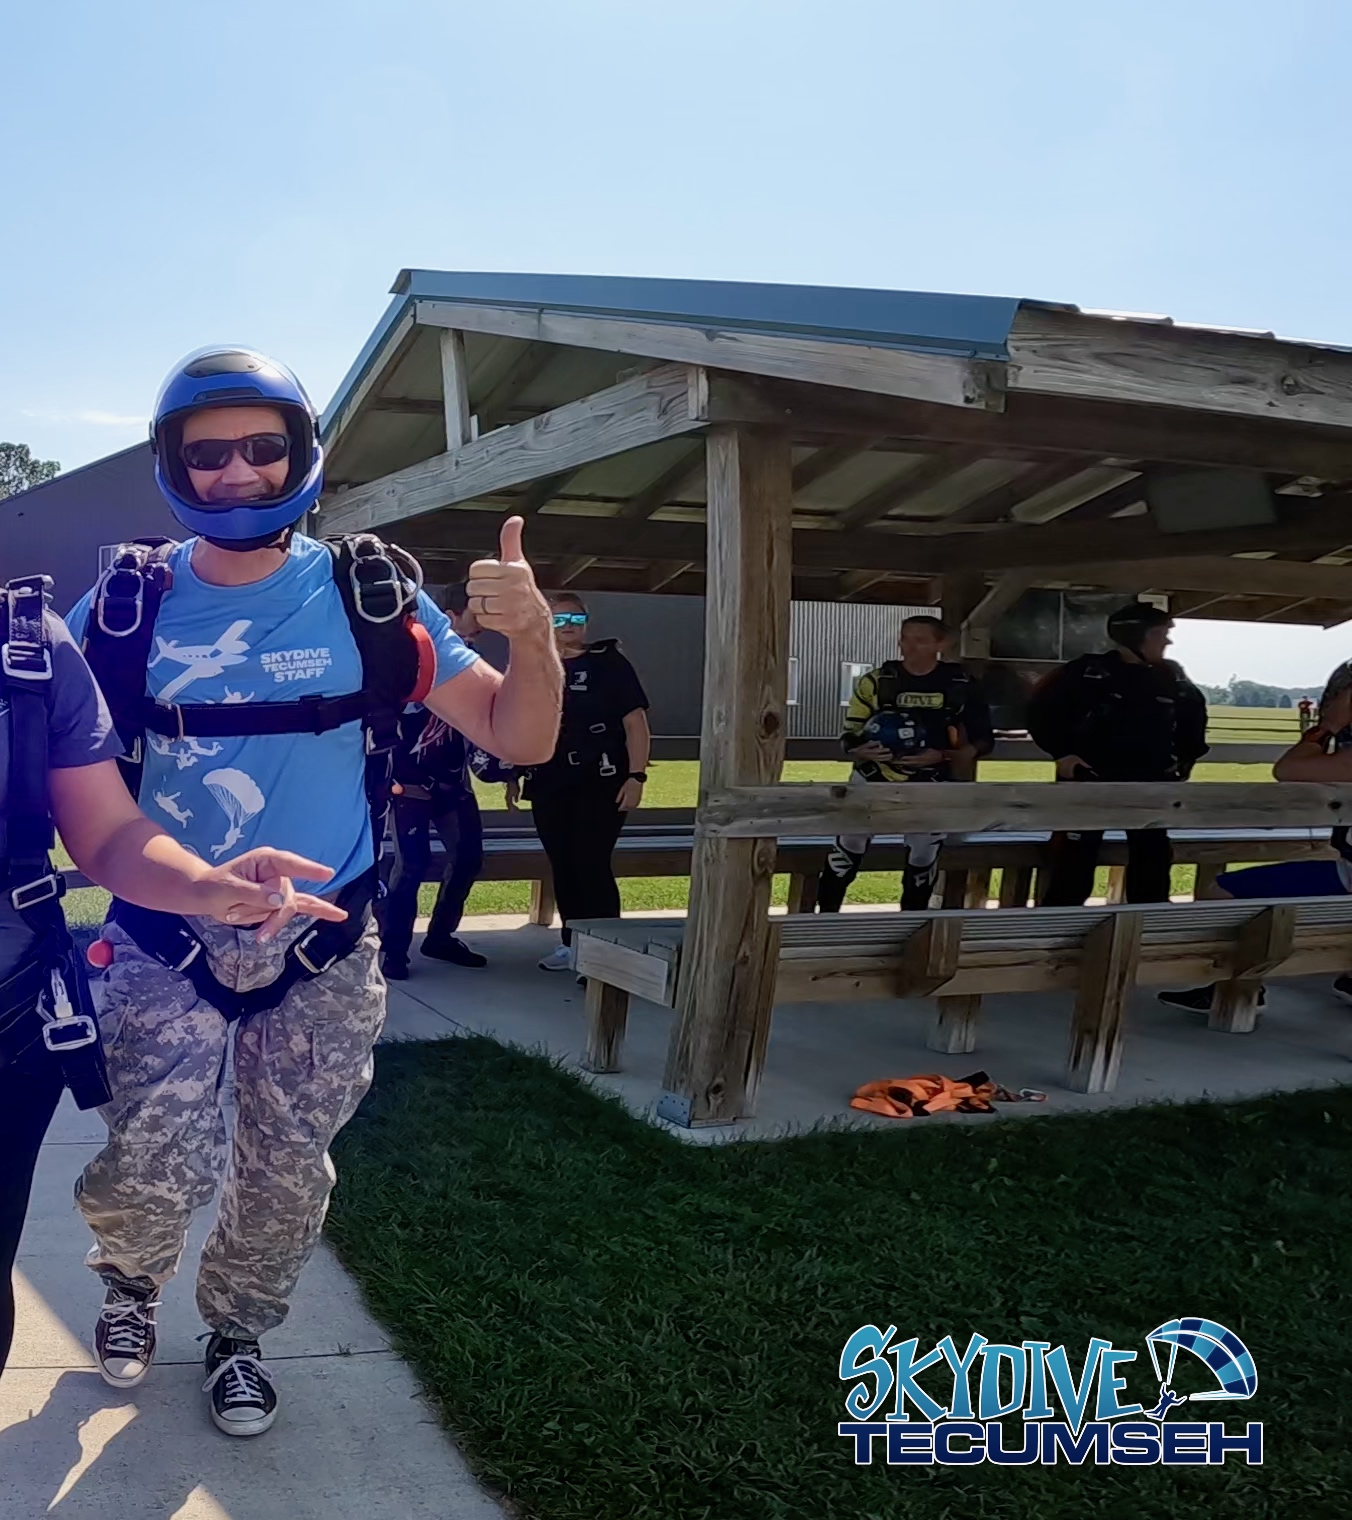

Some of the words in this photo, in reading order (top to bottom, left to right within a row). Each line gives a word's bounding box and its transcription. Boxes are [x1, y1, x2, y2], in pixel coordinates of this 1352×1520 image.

[261, 648, 330, 663] SKYDIVE
[263, 658, 332, 672] TECUMSEH
[274, 668, 325, 682] STAFF
